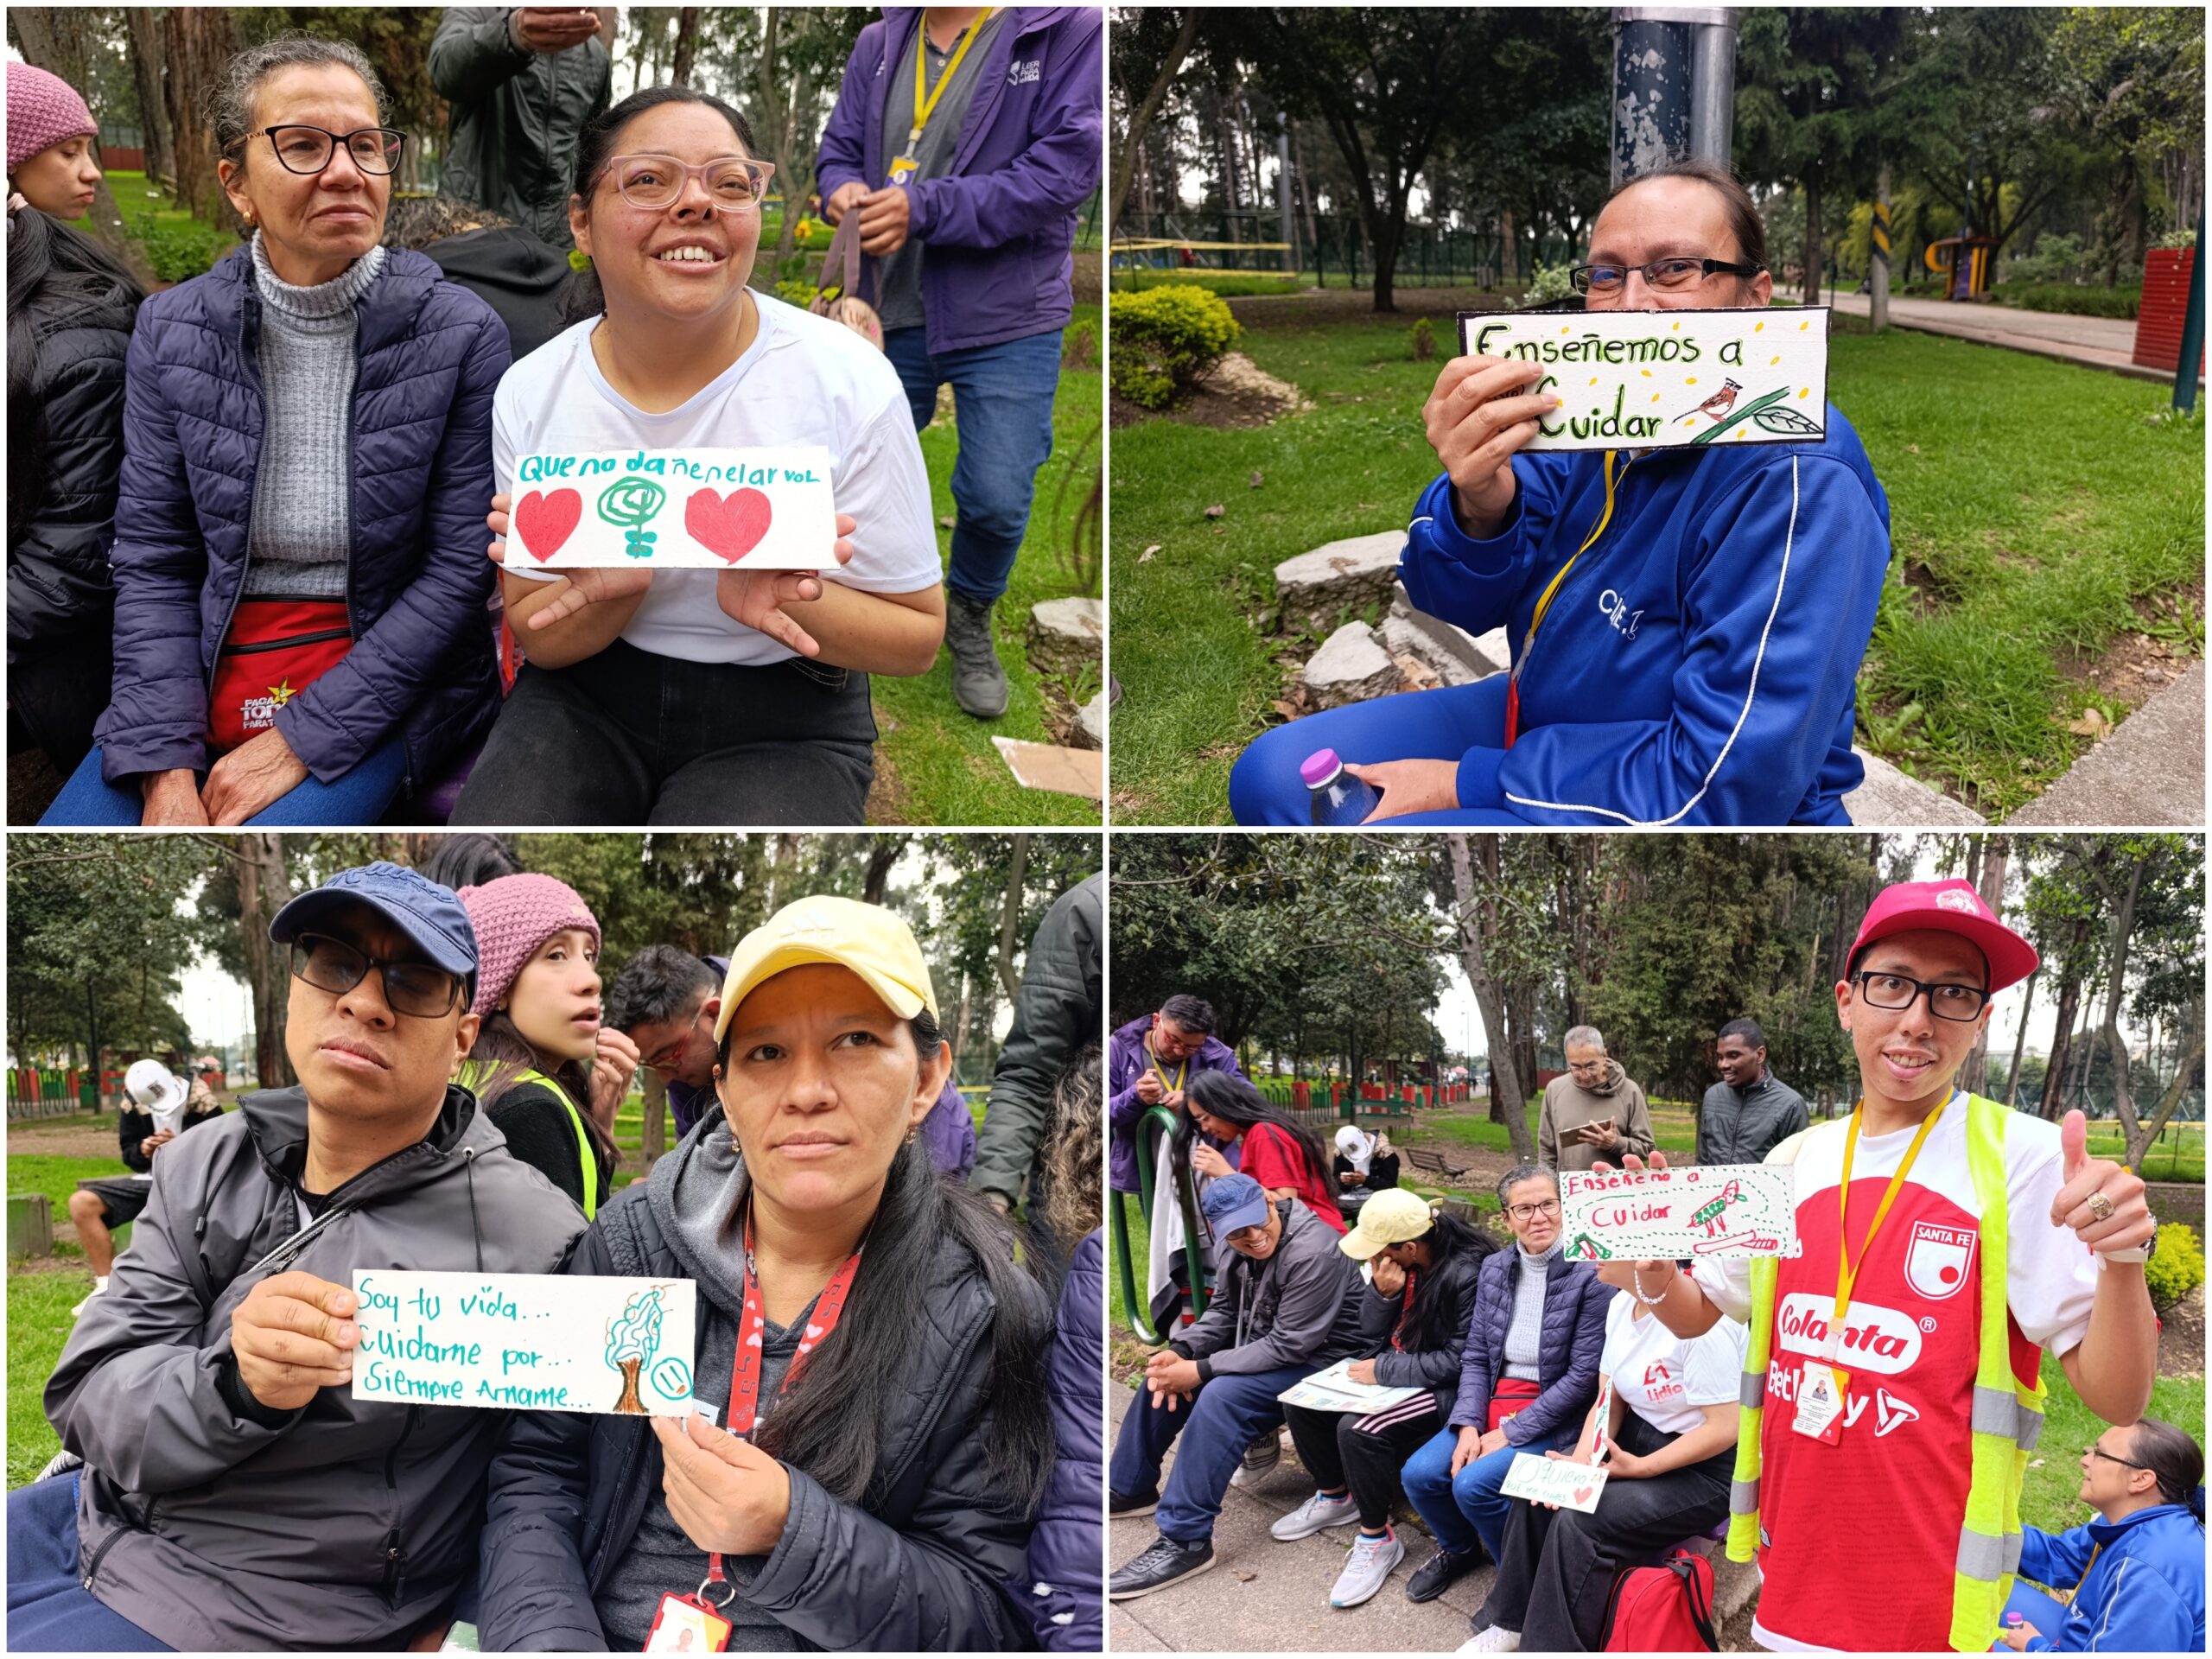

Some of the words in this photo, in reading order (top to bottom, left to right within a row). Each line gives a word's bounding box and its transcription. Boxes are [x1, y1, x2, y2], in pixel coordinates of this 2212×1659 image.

[1476, 323, 1701, 363] Enseñemos
[1719, 337, 1744, 366] a
[1535, 375, 1662, 439] Cuidar
[578, 457, 617, 477] no
[245, 696, 275, 707] PAGA
[1687, 1172, 1700, 1183] a
[1592, 1204, 1671, 1227] Cuidar
[1916, 1227, 1953, 1244] SANTA
[1955, 1233, 1972, 1247] FE
[358, 1277, 398, 1323] Soy
[359, 1324, 481, 1366] Cuidame
